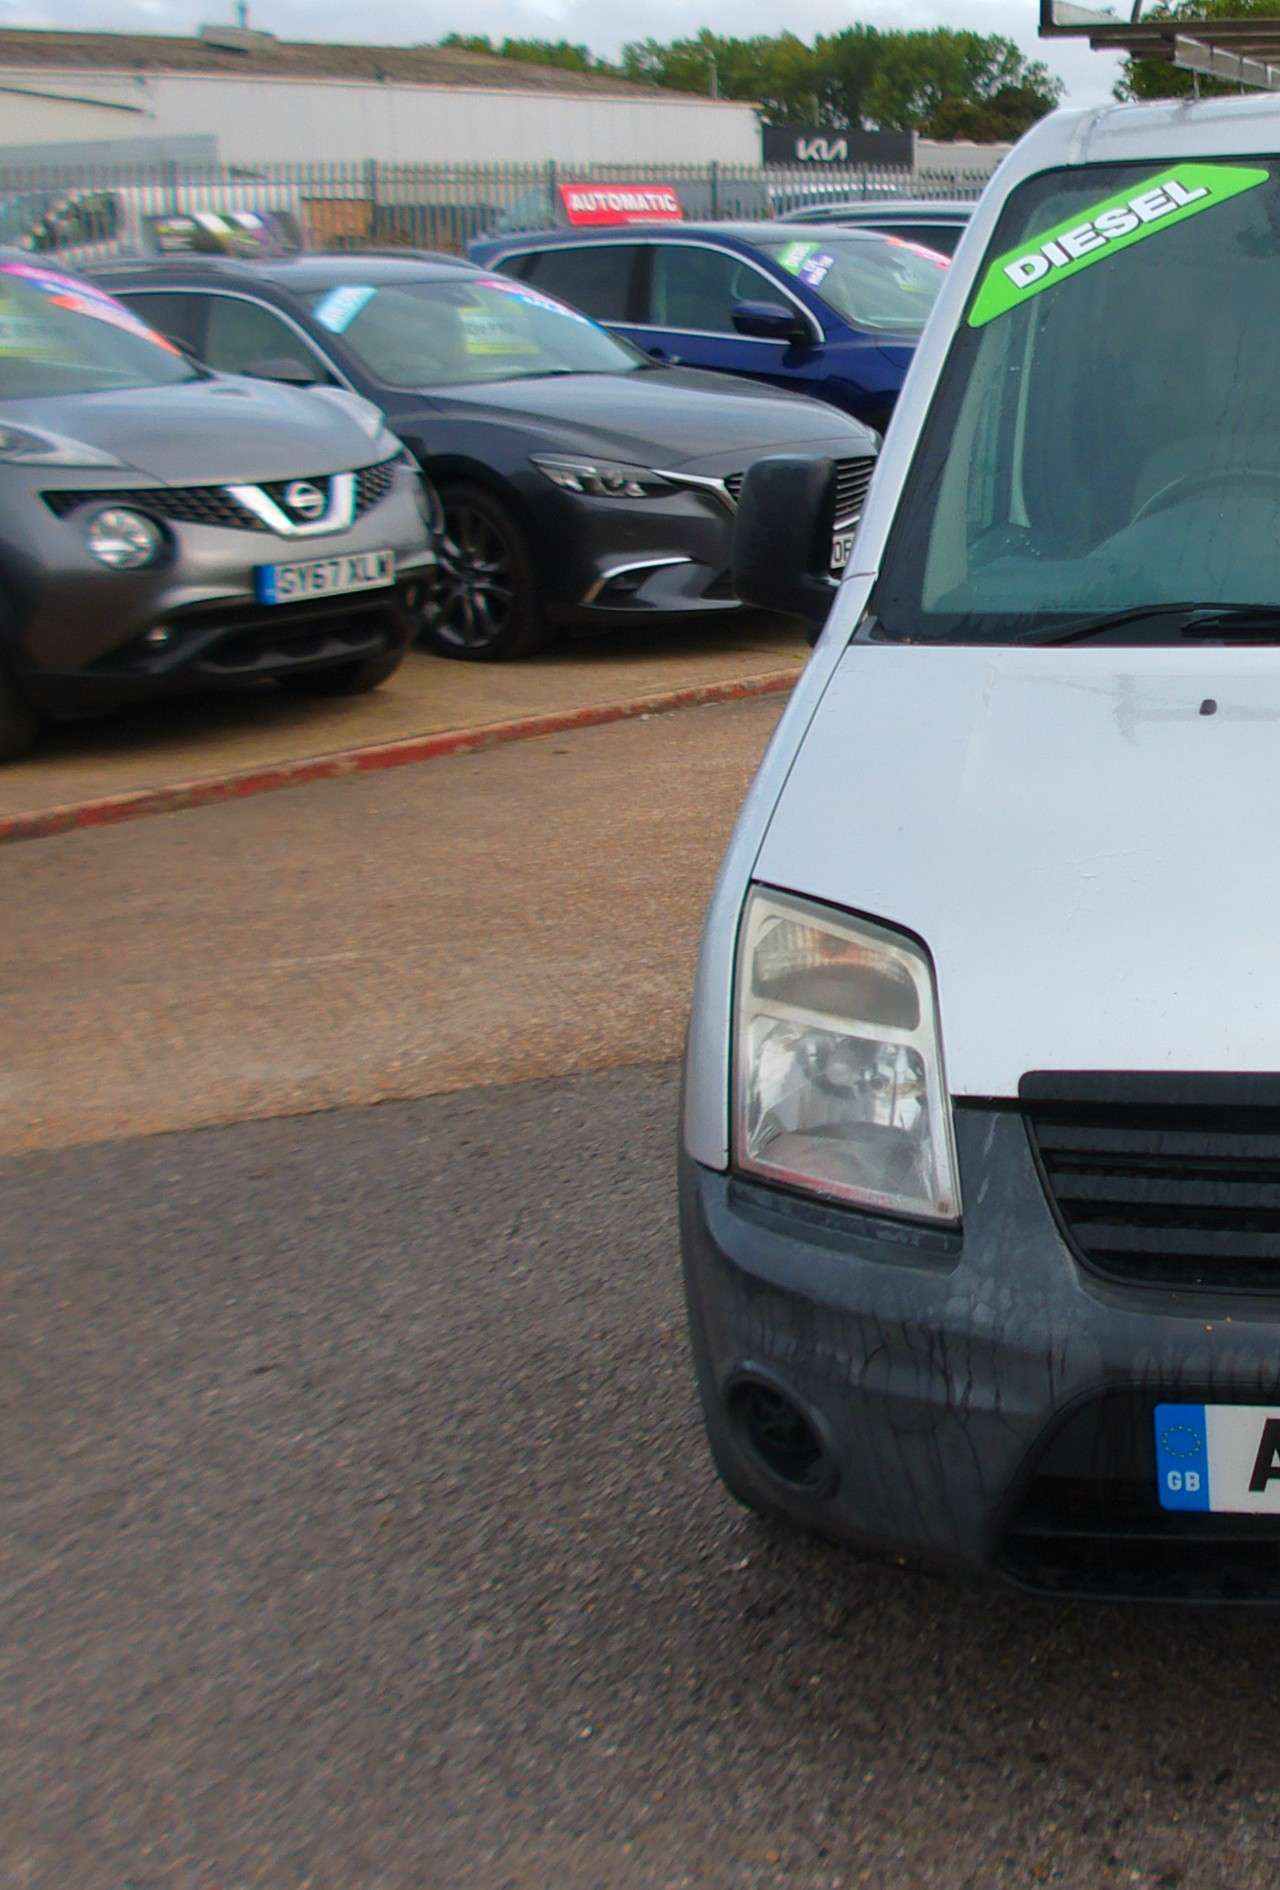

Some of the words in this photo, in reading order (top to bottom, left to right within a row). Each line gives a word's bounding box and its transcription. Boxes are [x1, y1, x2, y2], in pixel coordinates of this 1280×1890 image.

[570, 193, 678, 212] AUTOMATIC
[1002, 180, 1212, 289] DIESEL
[1167, 1470, 1201, 1492] GB
